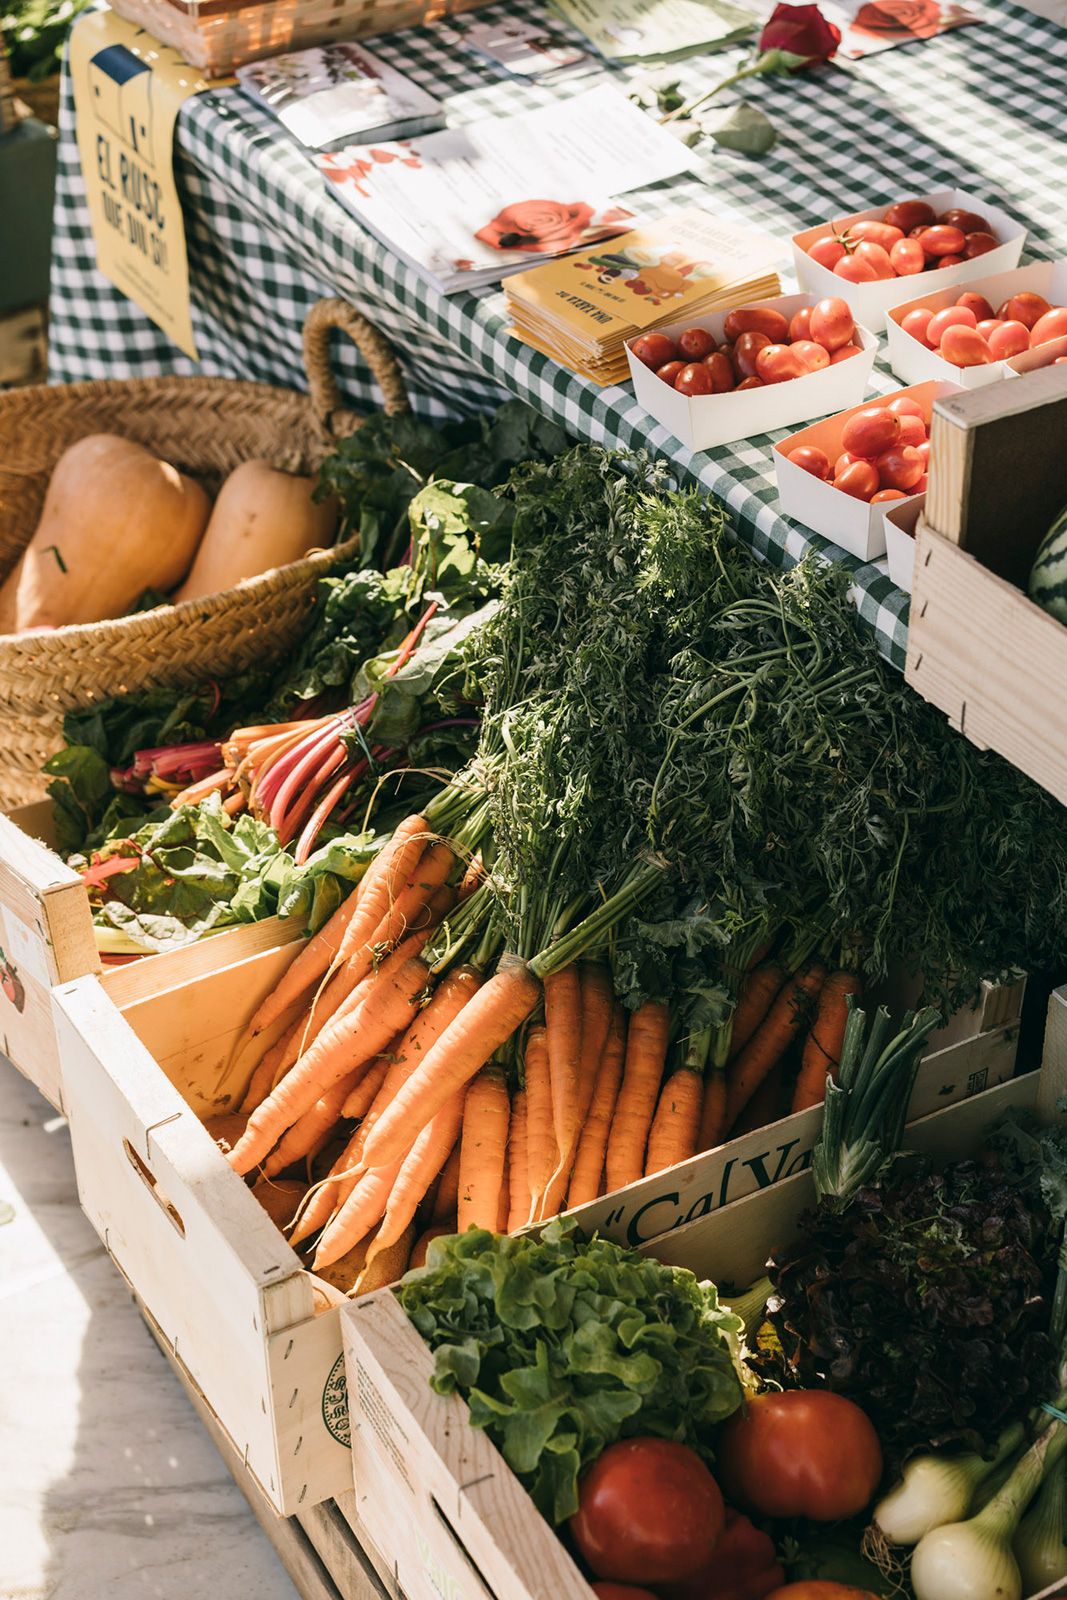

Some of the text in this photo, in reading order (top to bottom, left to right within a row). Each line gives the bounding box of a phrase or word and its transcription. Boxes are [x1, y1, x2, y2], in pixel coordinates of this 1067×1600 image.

[97, 134, 165, 230] EL RUSC
[589, 310, 613, 325] UNA
